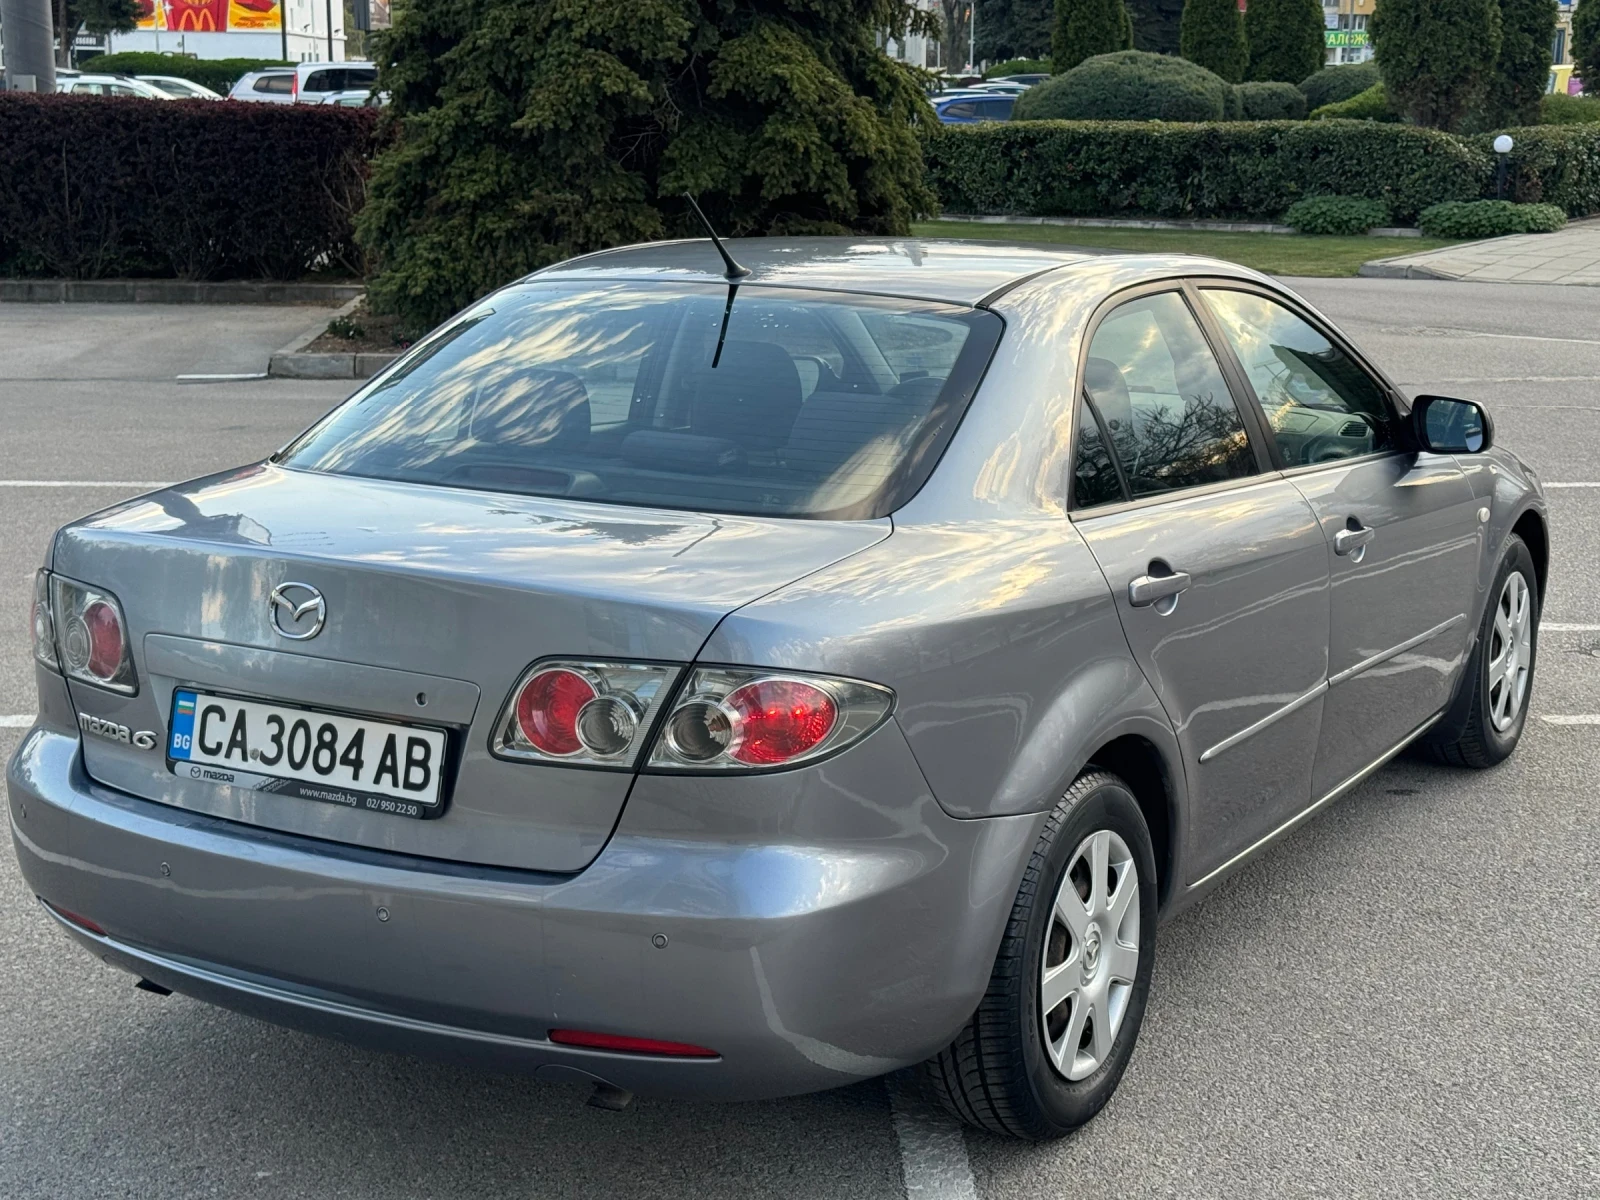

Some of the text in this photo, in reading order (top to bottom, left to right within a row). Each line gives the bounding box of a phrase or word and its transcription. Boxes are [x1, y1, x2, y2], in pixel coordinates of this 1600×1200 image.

[1325, 33, 1370, 45] АЛОЖ
[132, 731, 158, 750] 6
[173, 733, 191, 750] BG
[198, 704, 431, 792] CA 3084 AB
[203, 769, 235, 783] mazda
[299, 787, 358, 807] www.mazda.bg
